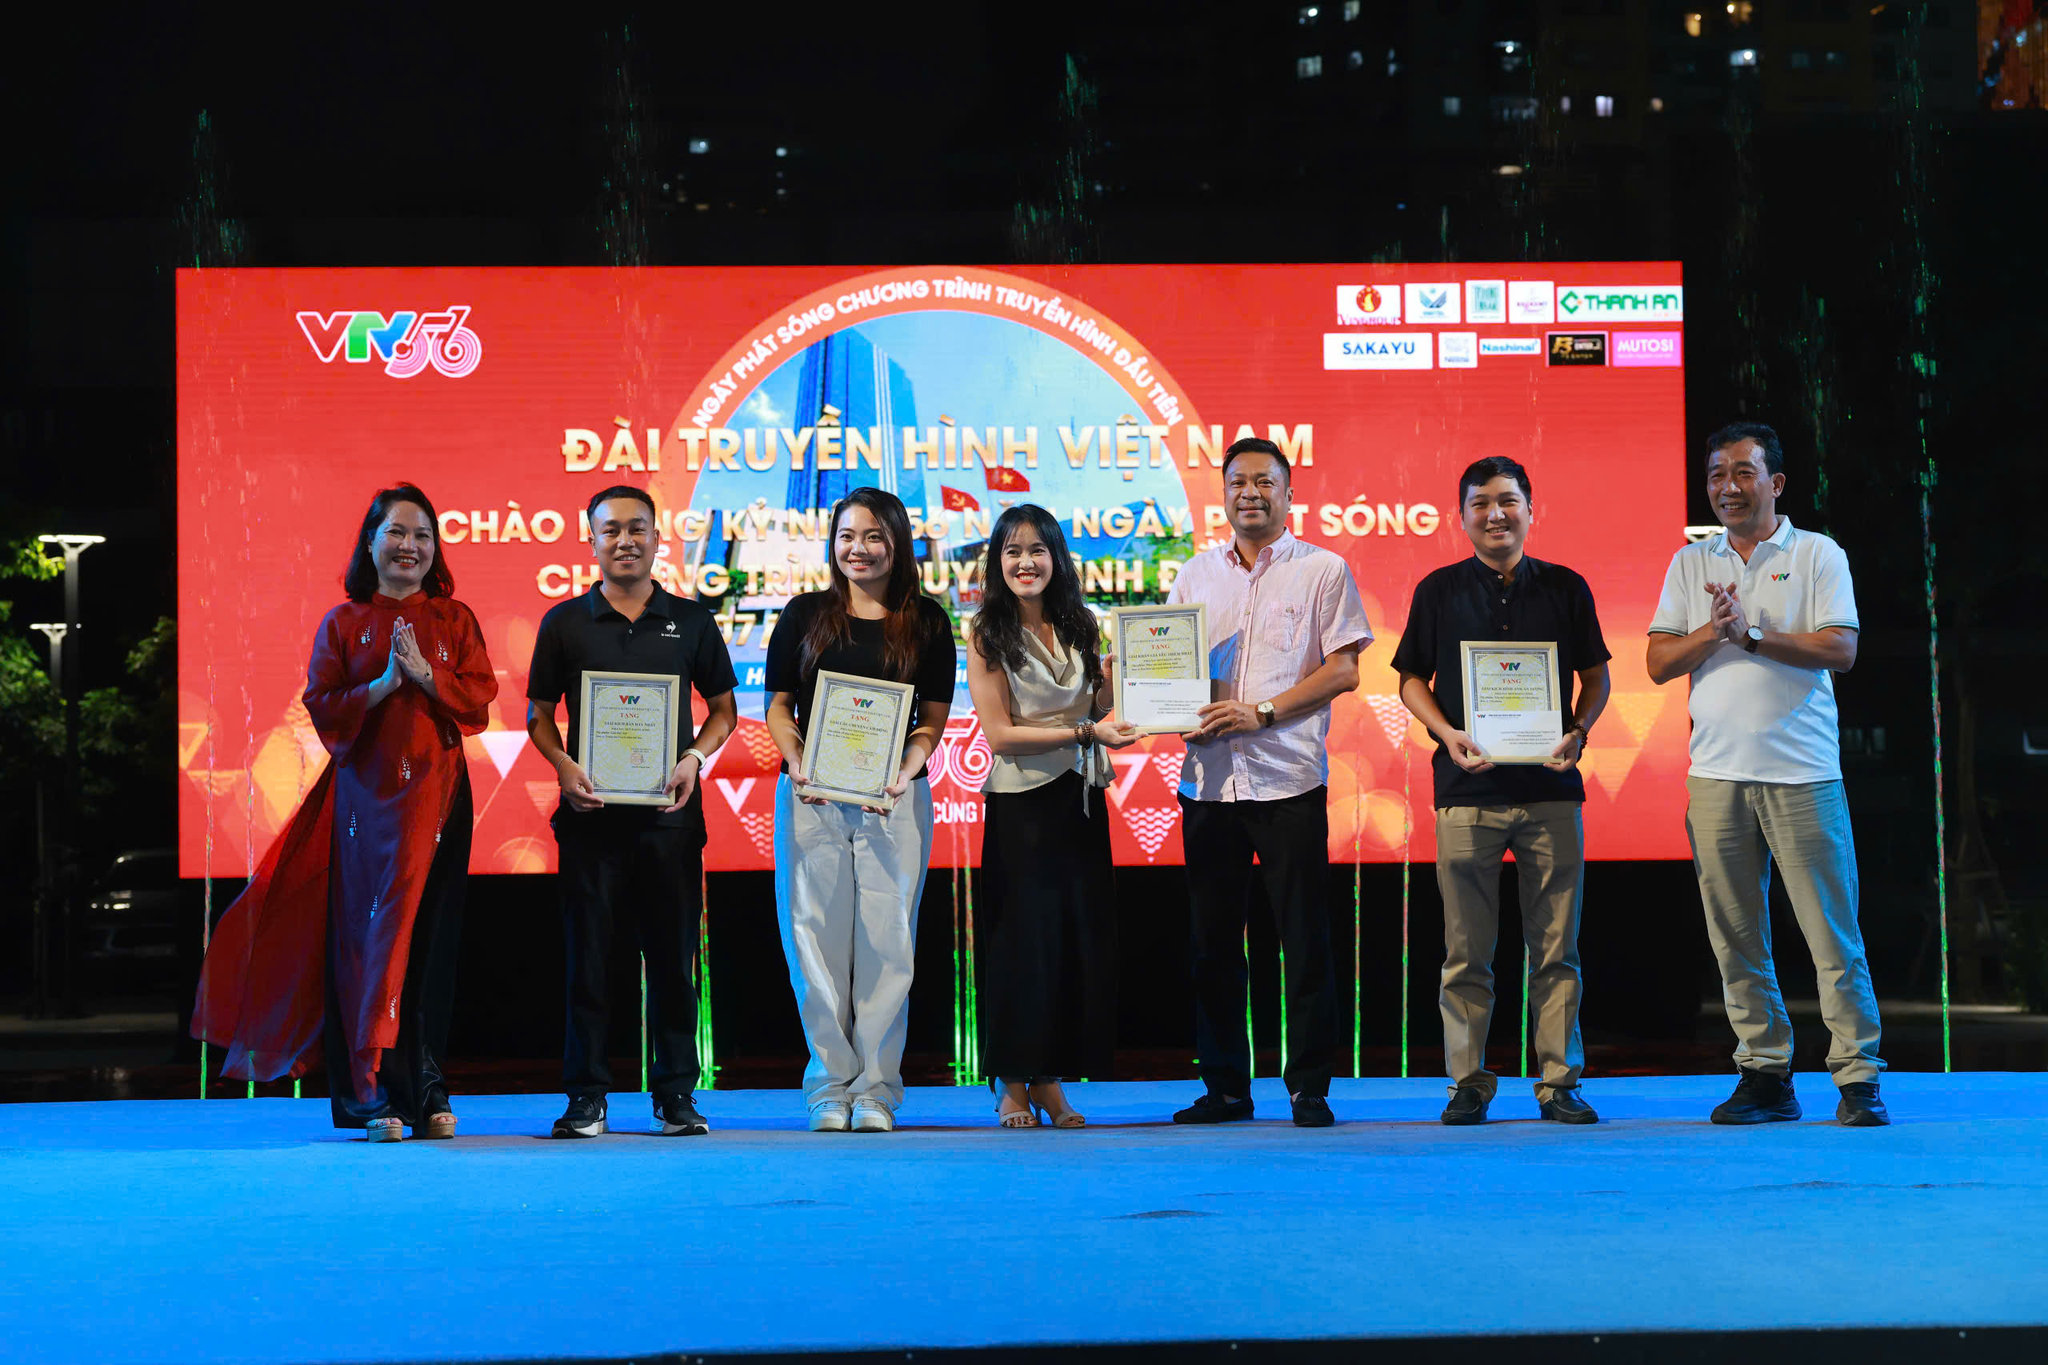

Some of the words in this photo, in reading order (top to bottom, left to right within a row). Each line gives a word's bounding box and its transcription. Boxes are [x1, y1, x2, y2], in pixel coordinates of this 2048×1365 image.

[1585, 295, 1648, 310] THANH
[692, 372, 738, 429] NGÀY
[732, 333, 779, 380] PHÁT
[776, 303, 836, 344] SÓNG
[836, 279, 930, 314] CHƯƠNG
[932, 276, 992, 301] TRÌNH
[1069, 318, 1118, 356] HÌNH
[1147, 382, 1184, 426] TIÊN
[1343, 341, 1416, 355] SAKAYU
[1617, 339, 1674, 353] MUTOSI
[562, 415, 661, 472] ĐÀI
[678, 403, 883, 472] TRUYỀN
[902, 413, 1039, 470] HÌNH
[1057, 413, 1170, 481] VIỆT
[437, 500, 565, 543] CHÀO
[1072, 497, 1190, 538] NGÀY
[1319, 494, 1440, 537] SÓNG
[1771, 573, 1790, 581] VTV
[1149, 627, 1170, 636] VTV
[1500, 662, 1521, 671] VTV
[619, 695, 640, 704] VTV
[853, 697, 873, 708] VTV
[933, 797, 978, 823] CÙNG
